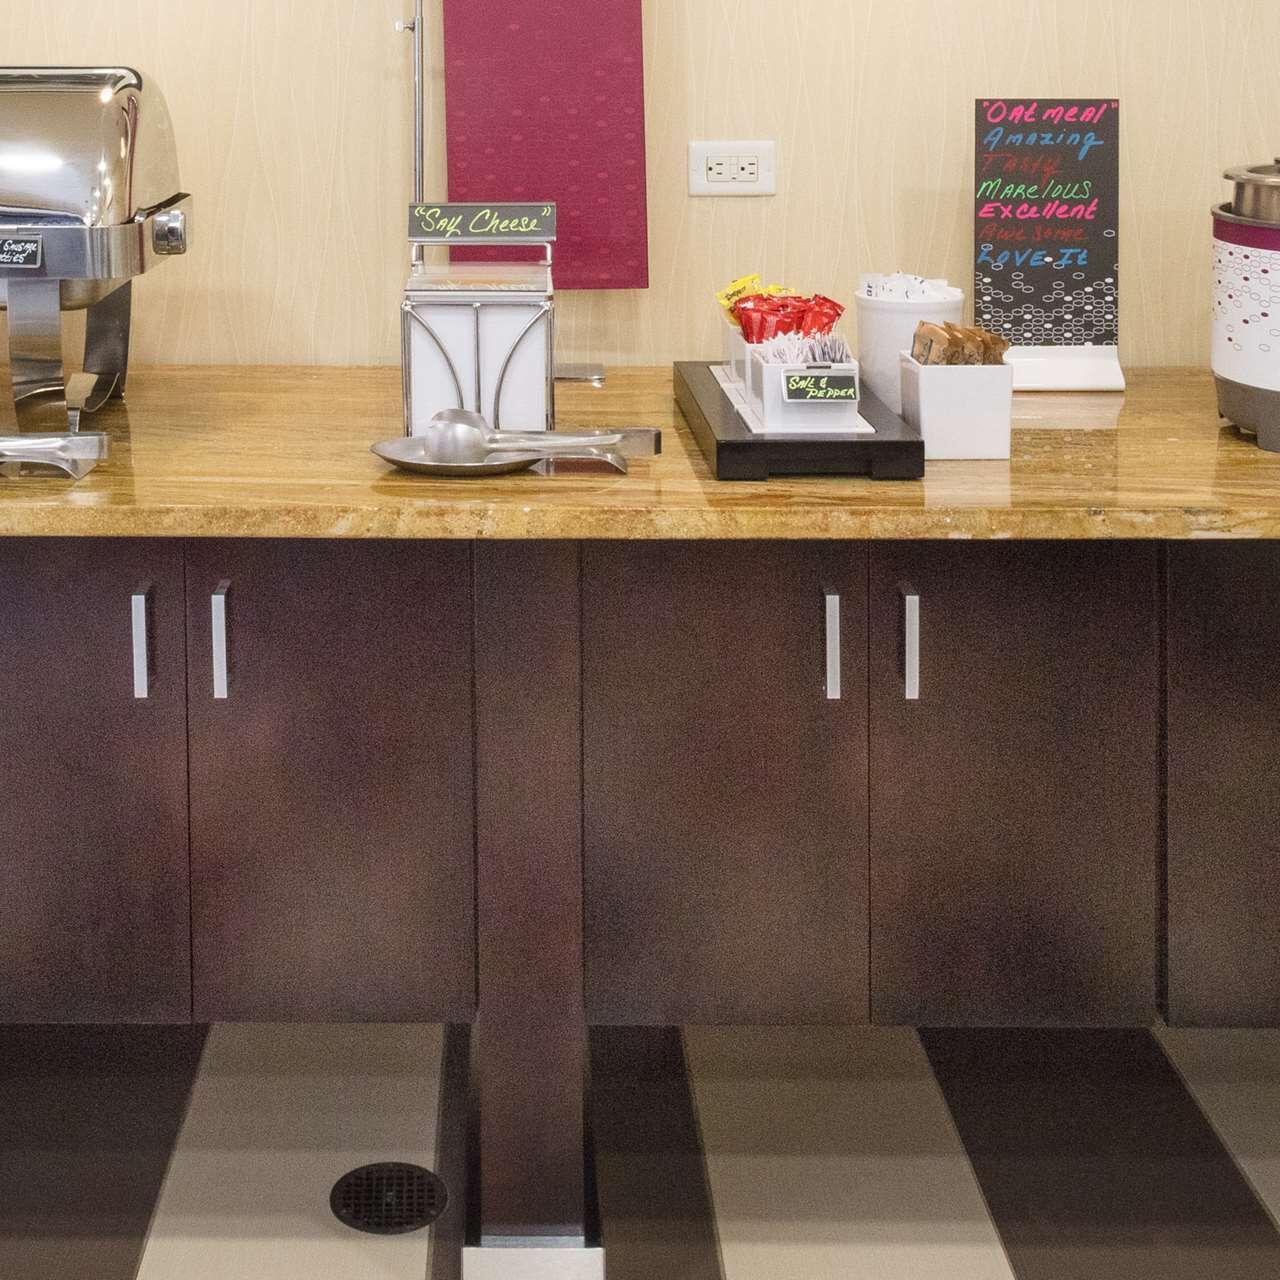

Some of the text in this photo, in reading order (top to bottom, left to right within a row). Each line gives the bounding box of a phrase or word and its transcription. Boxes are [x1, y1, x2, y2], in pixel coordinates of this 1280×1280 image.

[983, 127, 1105, 160] Amazing
[978, 198, 1099, 219] Excellent
[788, 376, 815, 390] Salt
